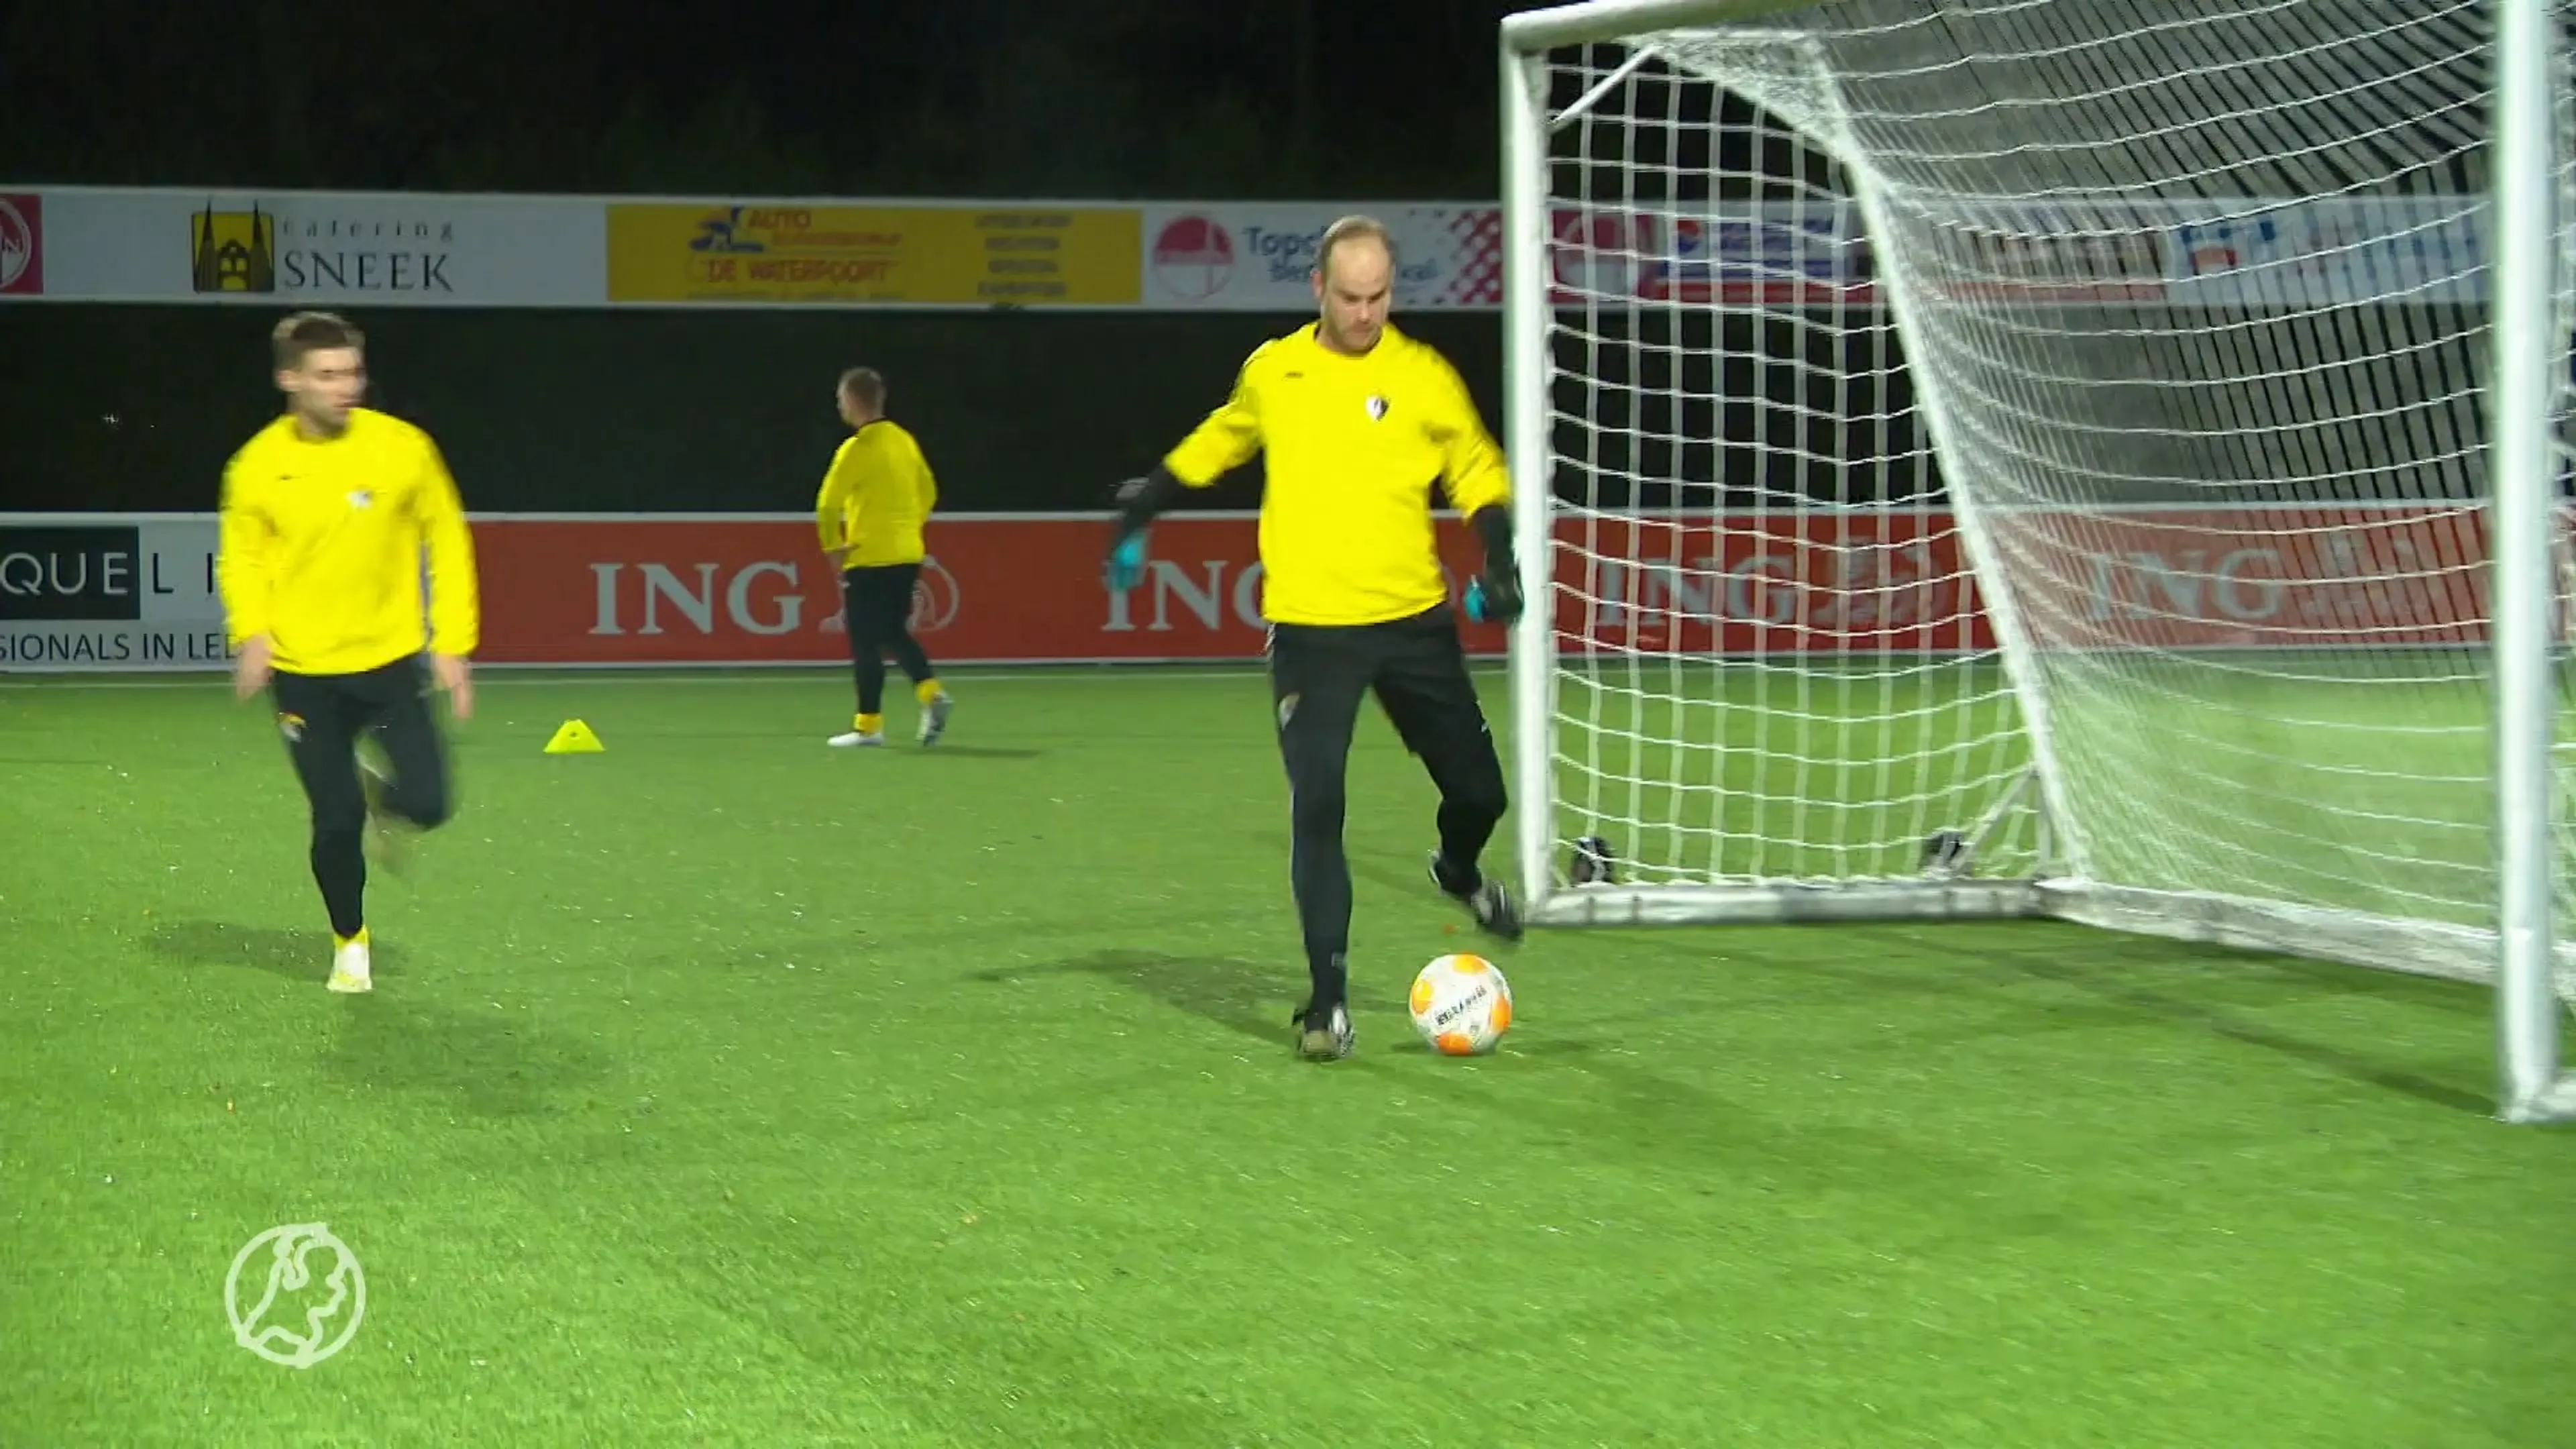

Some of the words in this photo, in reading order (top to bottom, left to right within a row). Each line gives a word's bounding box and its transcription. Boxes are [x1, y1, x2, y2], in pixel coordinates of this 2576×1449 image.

[284, 250, 453, 292] SNEEK
[588, 559, 806, 635] ING
[1596, 554, 1799, 627] ING
[143, 633, 174, 660] IN
